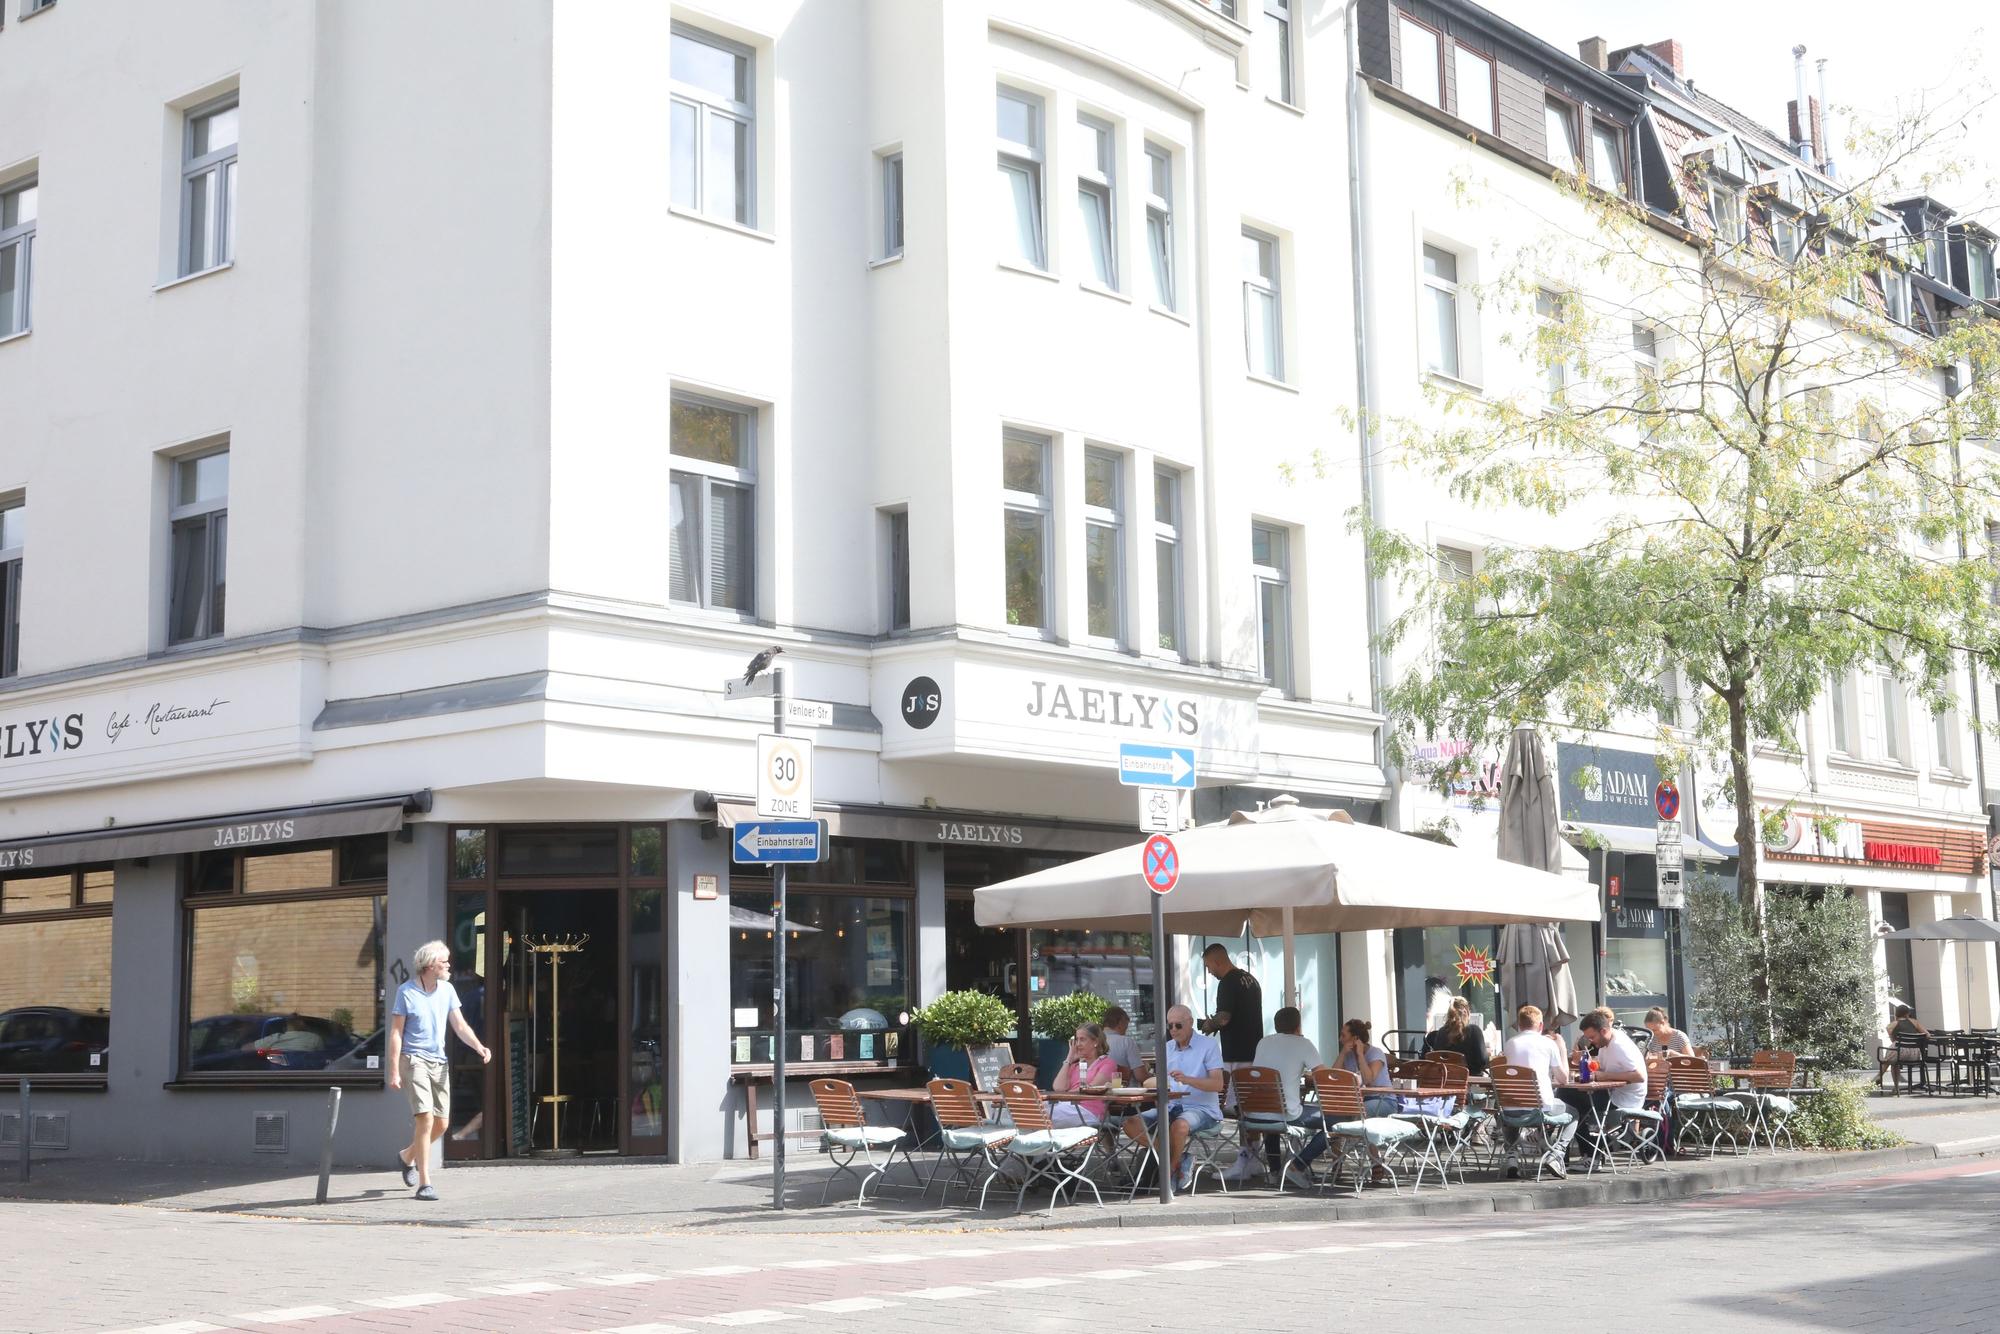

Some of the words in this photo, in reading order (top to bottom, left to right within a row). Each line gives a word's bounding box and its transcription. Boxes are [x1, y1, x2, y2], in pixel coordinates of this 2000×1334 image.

[145, 698, 230, 735] Restaurant
[788, 703, 816, 719] Venloer
[774, 757, 796, 782] 30
[1604, 770, 1649, 798] ADAM
[771, 798, 798, 813] ZONE
[1604, 794, 1649, 806] JUWELIER
[757, 835, 814, 848] Einbahnstraße
